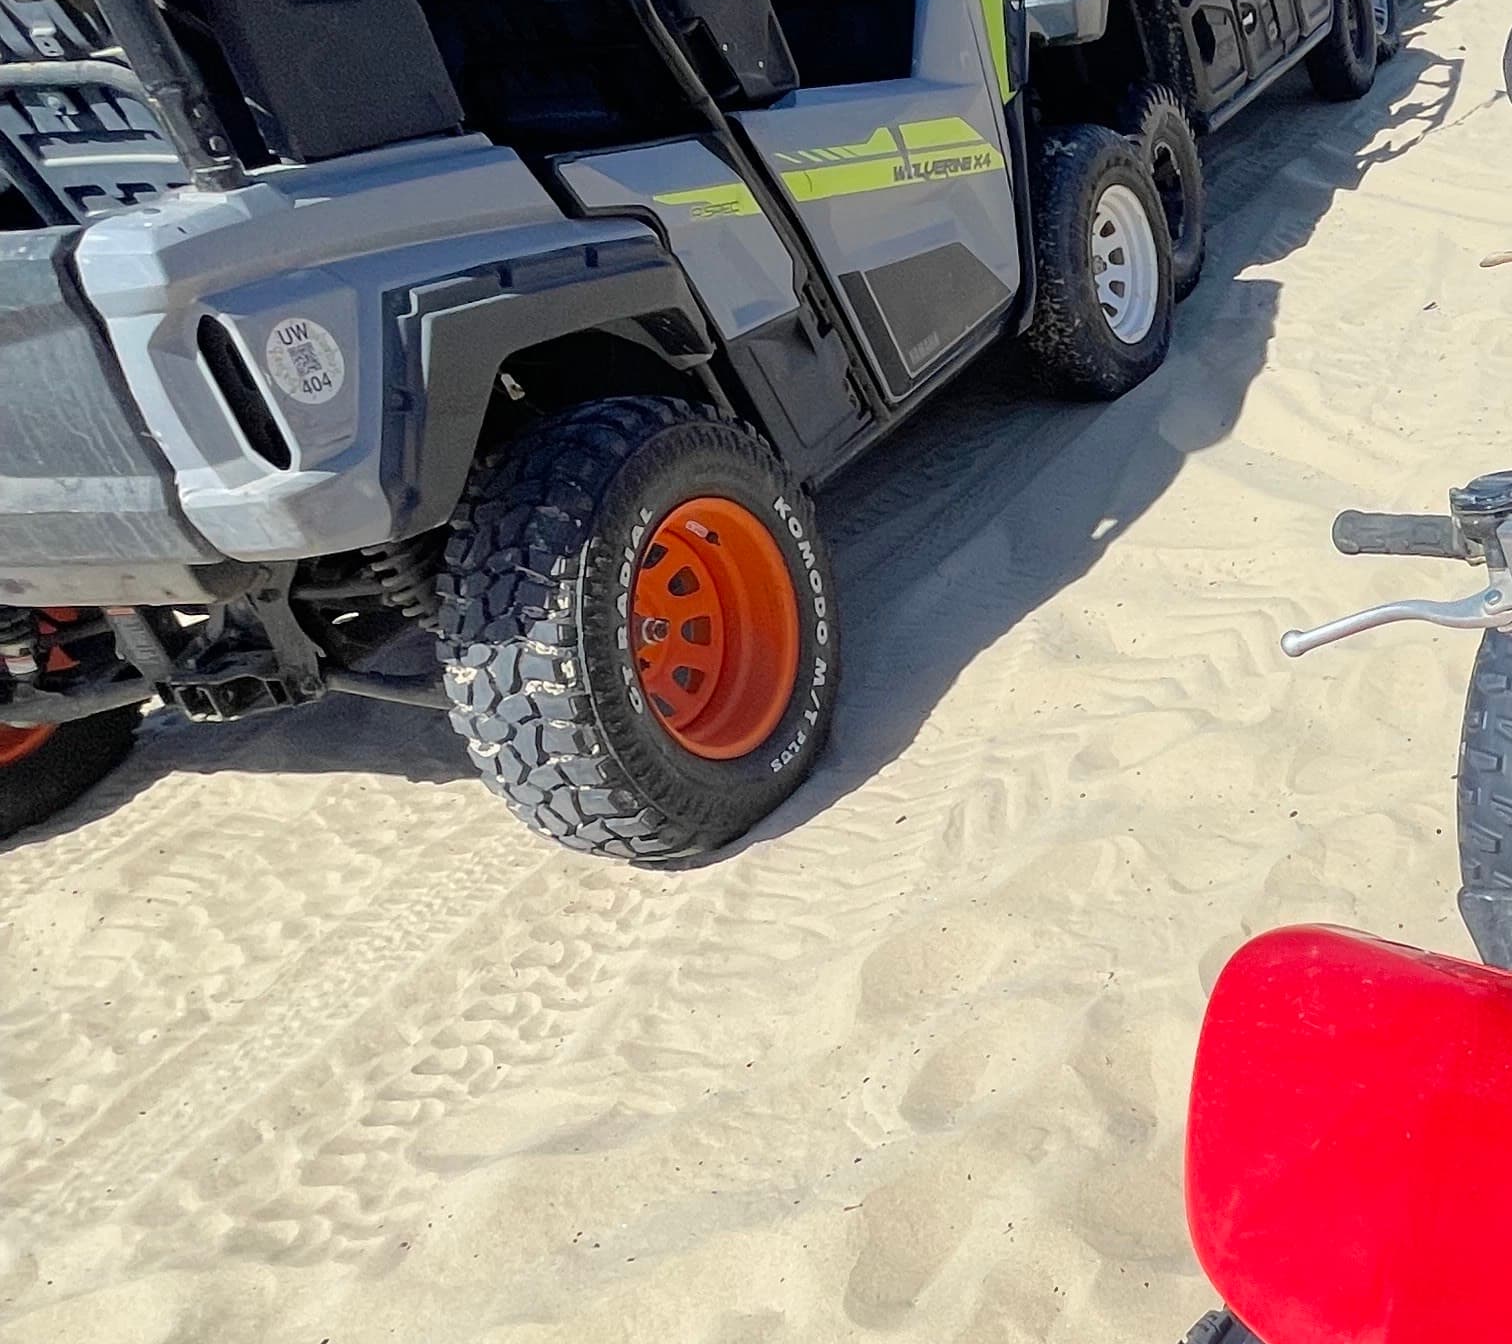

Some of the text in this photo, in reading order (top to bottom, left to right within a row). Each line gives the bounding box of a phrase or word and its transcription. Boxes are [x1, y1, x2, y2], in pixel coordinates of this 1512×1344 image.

[974, 153, 991, 170] X4
[277, 322, 308, 345] UW
[303, 372, 332, 394] 404
[617, 508, 653, 649] RADIAL
[770, 496, 828, 773] KOMODO M/T PLUS
